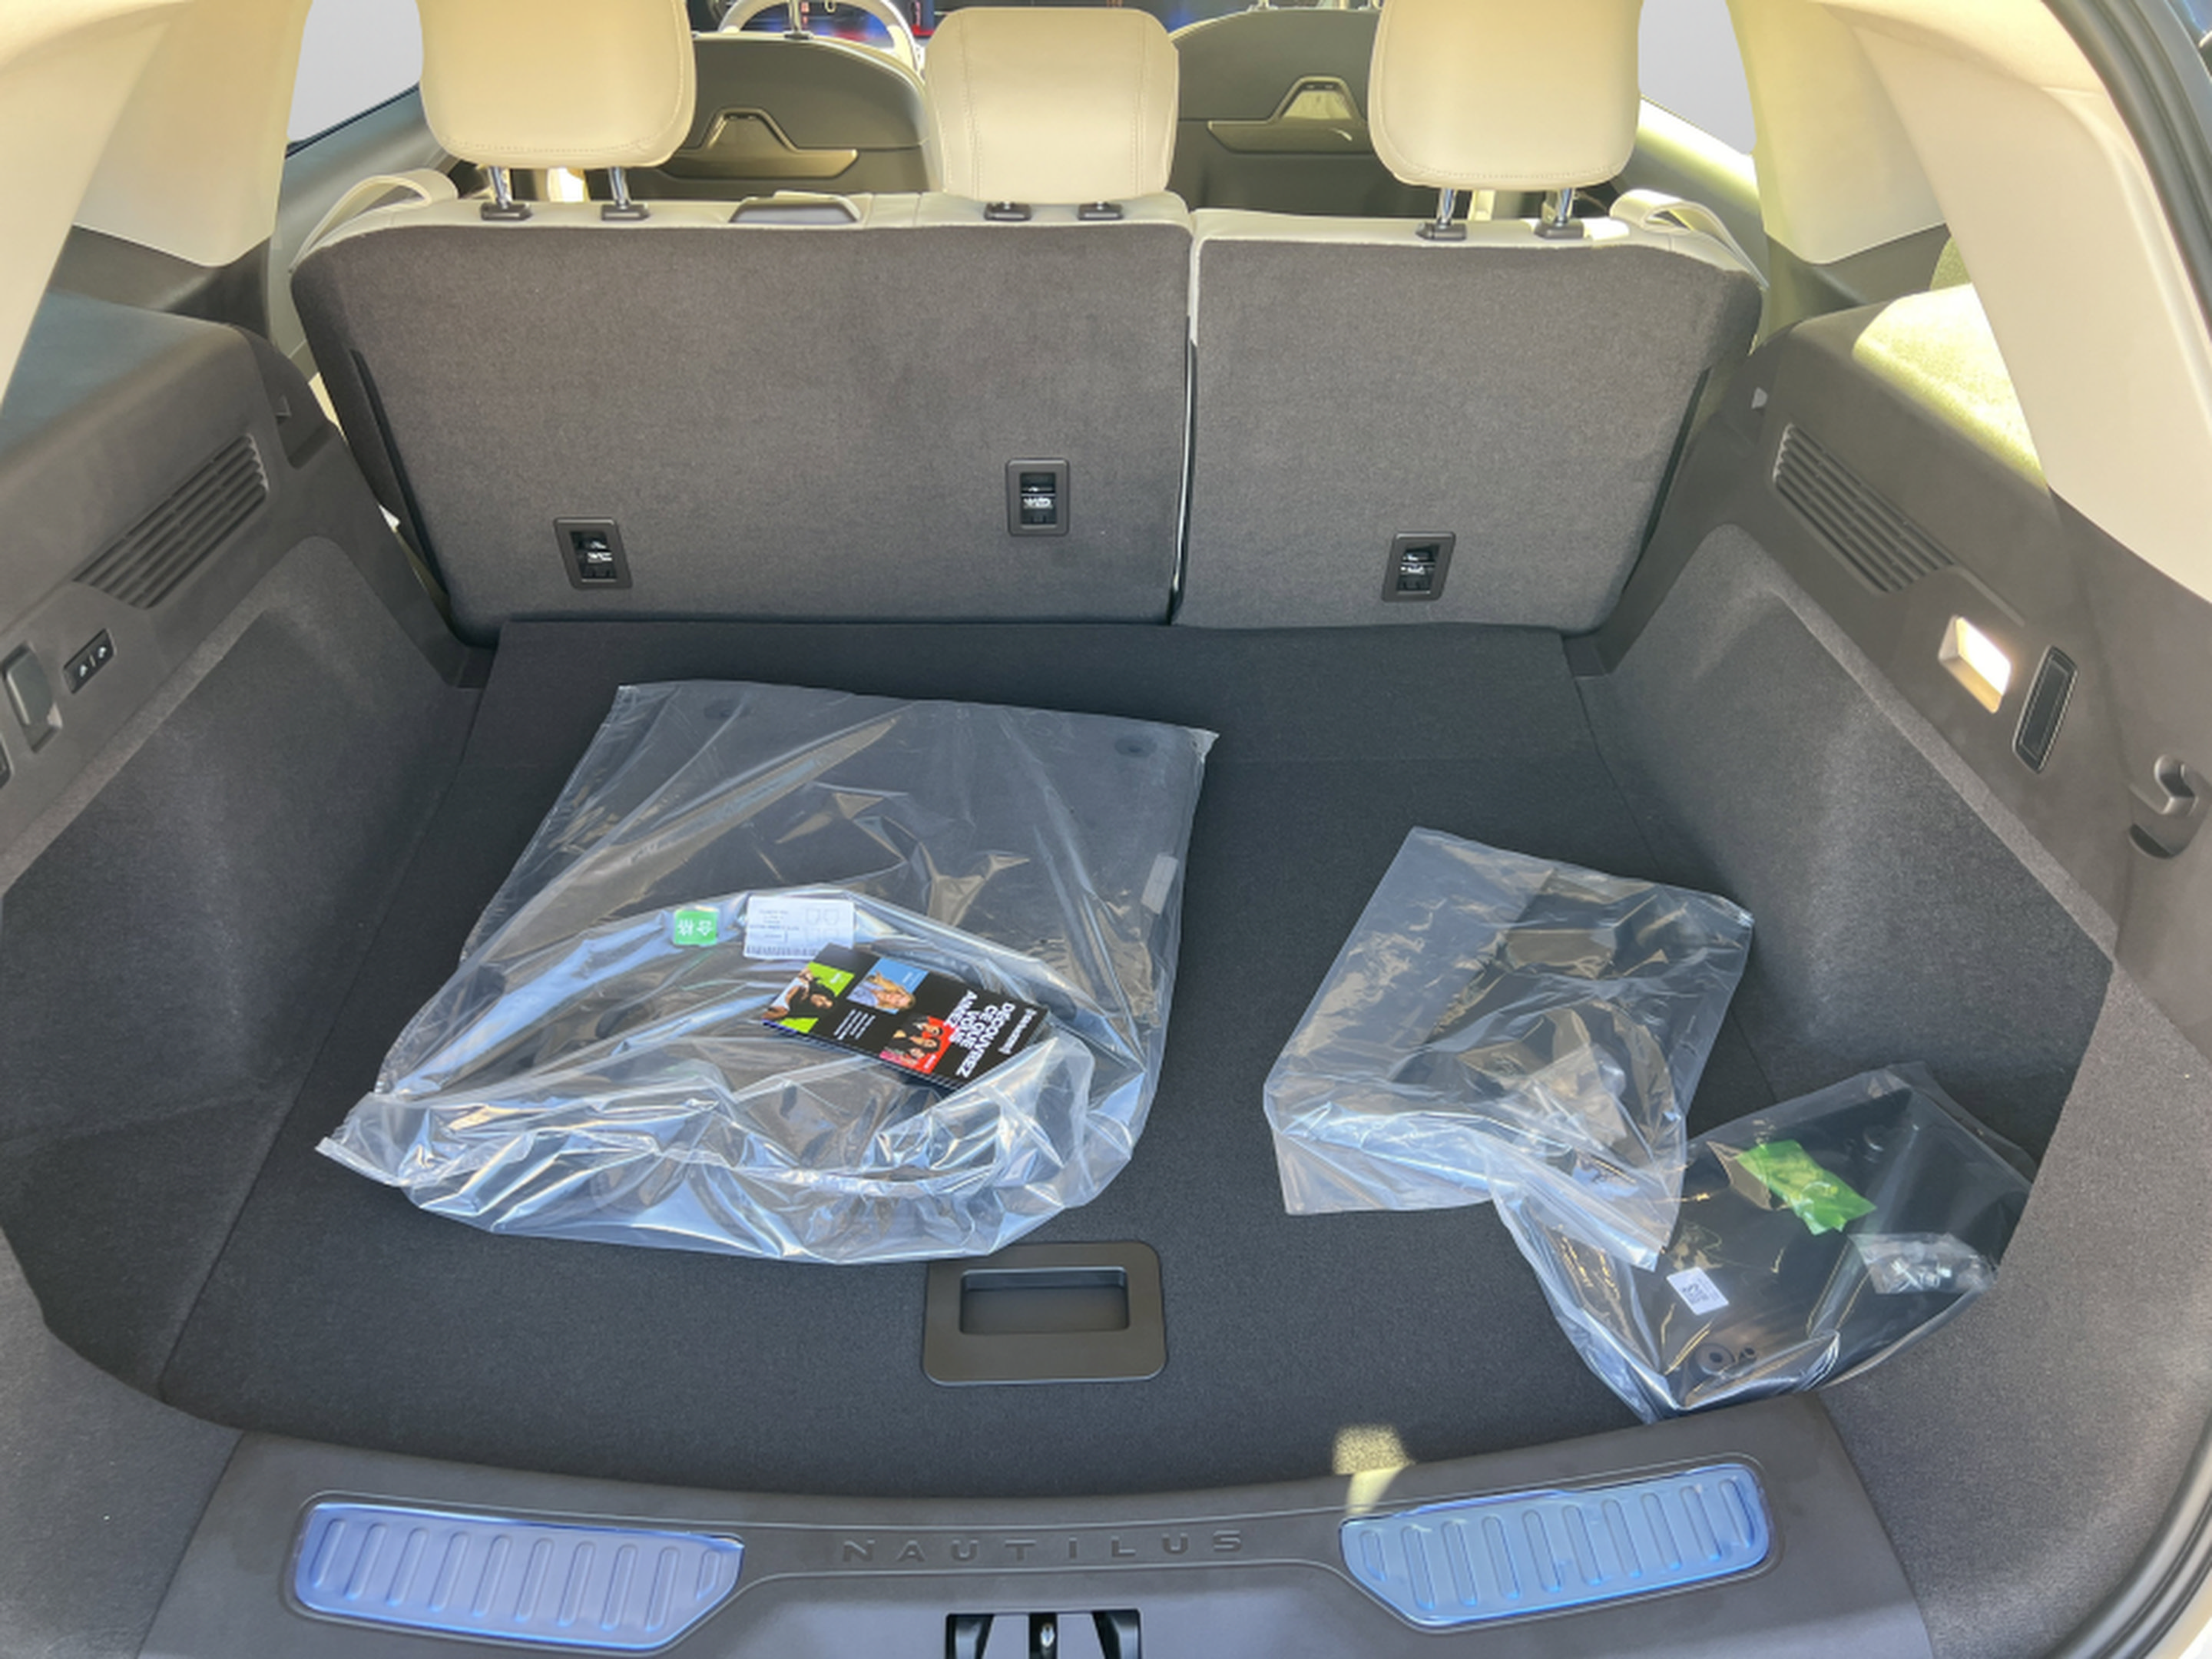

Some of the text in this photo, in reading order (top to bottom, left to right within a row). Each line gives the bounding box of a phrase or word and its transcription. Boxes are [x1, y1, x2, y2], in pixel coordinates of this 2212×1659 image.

[943, 990, 978, 1028] AIMEZ
[949, 1011, 982, 1043] VOUS
[959, 1005, 998, 1049] CE QUE
[955, 1002, 1016, 1078] DÉCOUVREZ
[843, 1530, 1243, 1563] NAUTILUS
